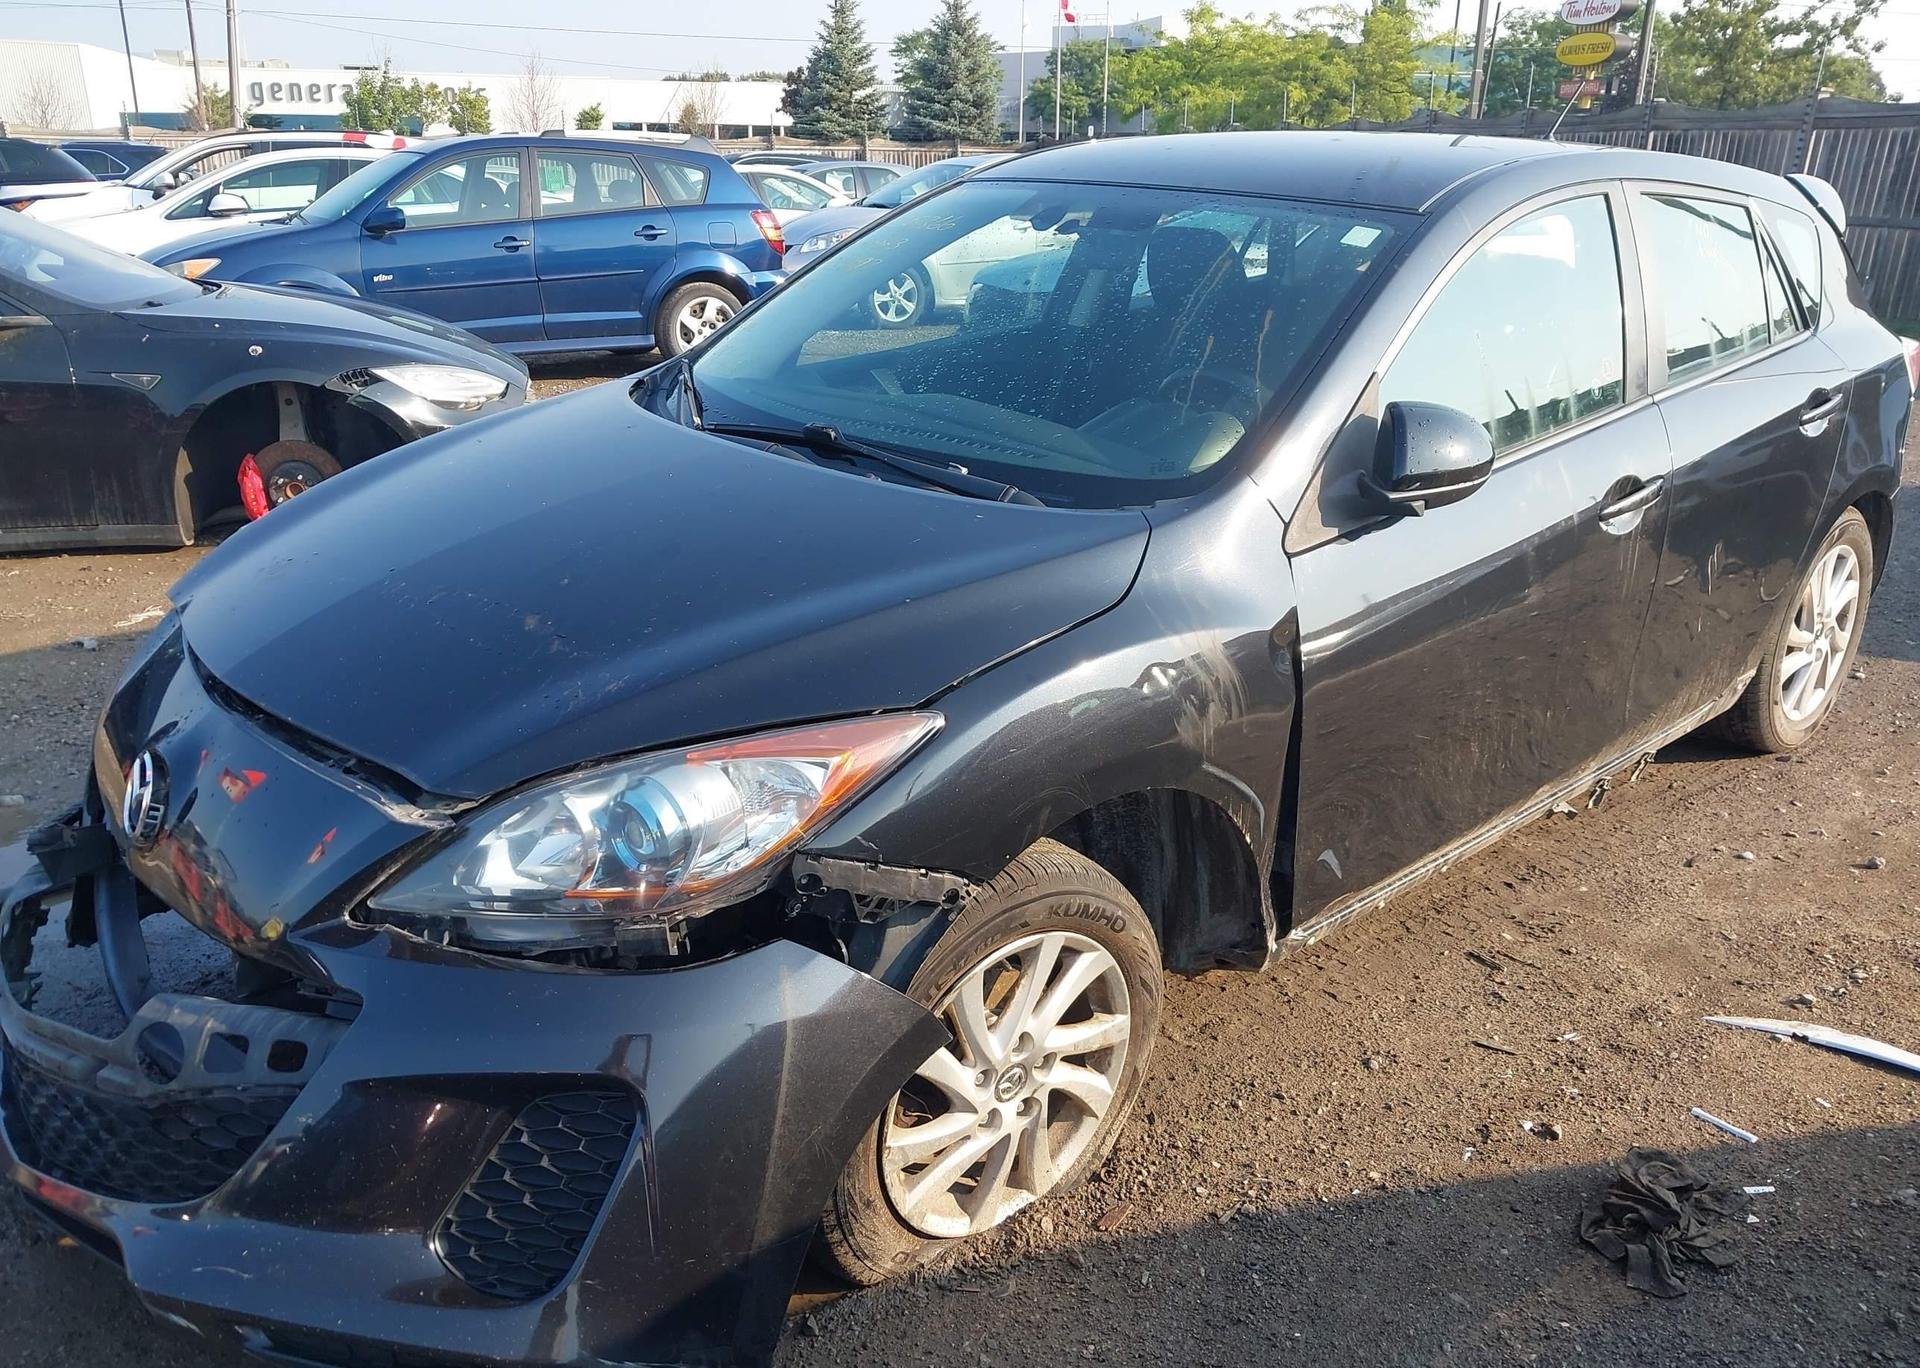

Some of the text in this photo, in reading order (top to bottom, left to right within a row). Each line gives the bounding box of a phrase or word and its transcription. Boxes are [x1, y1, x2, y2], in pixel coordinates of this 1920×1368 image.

[1566, 0, 1616, 19] Tim Hortons
[1561, 42, 1611, 56] ALWAYS FRESH
[250, 82, 358, 107] genera
[1047, 902, 1126, 933] KUMHO
